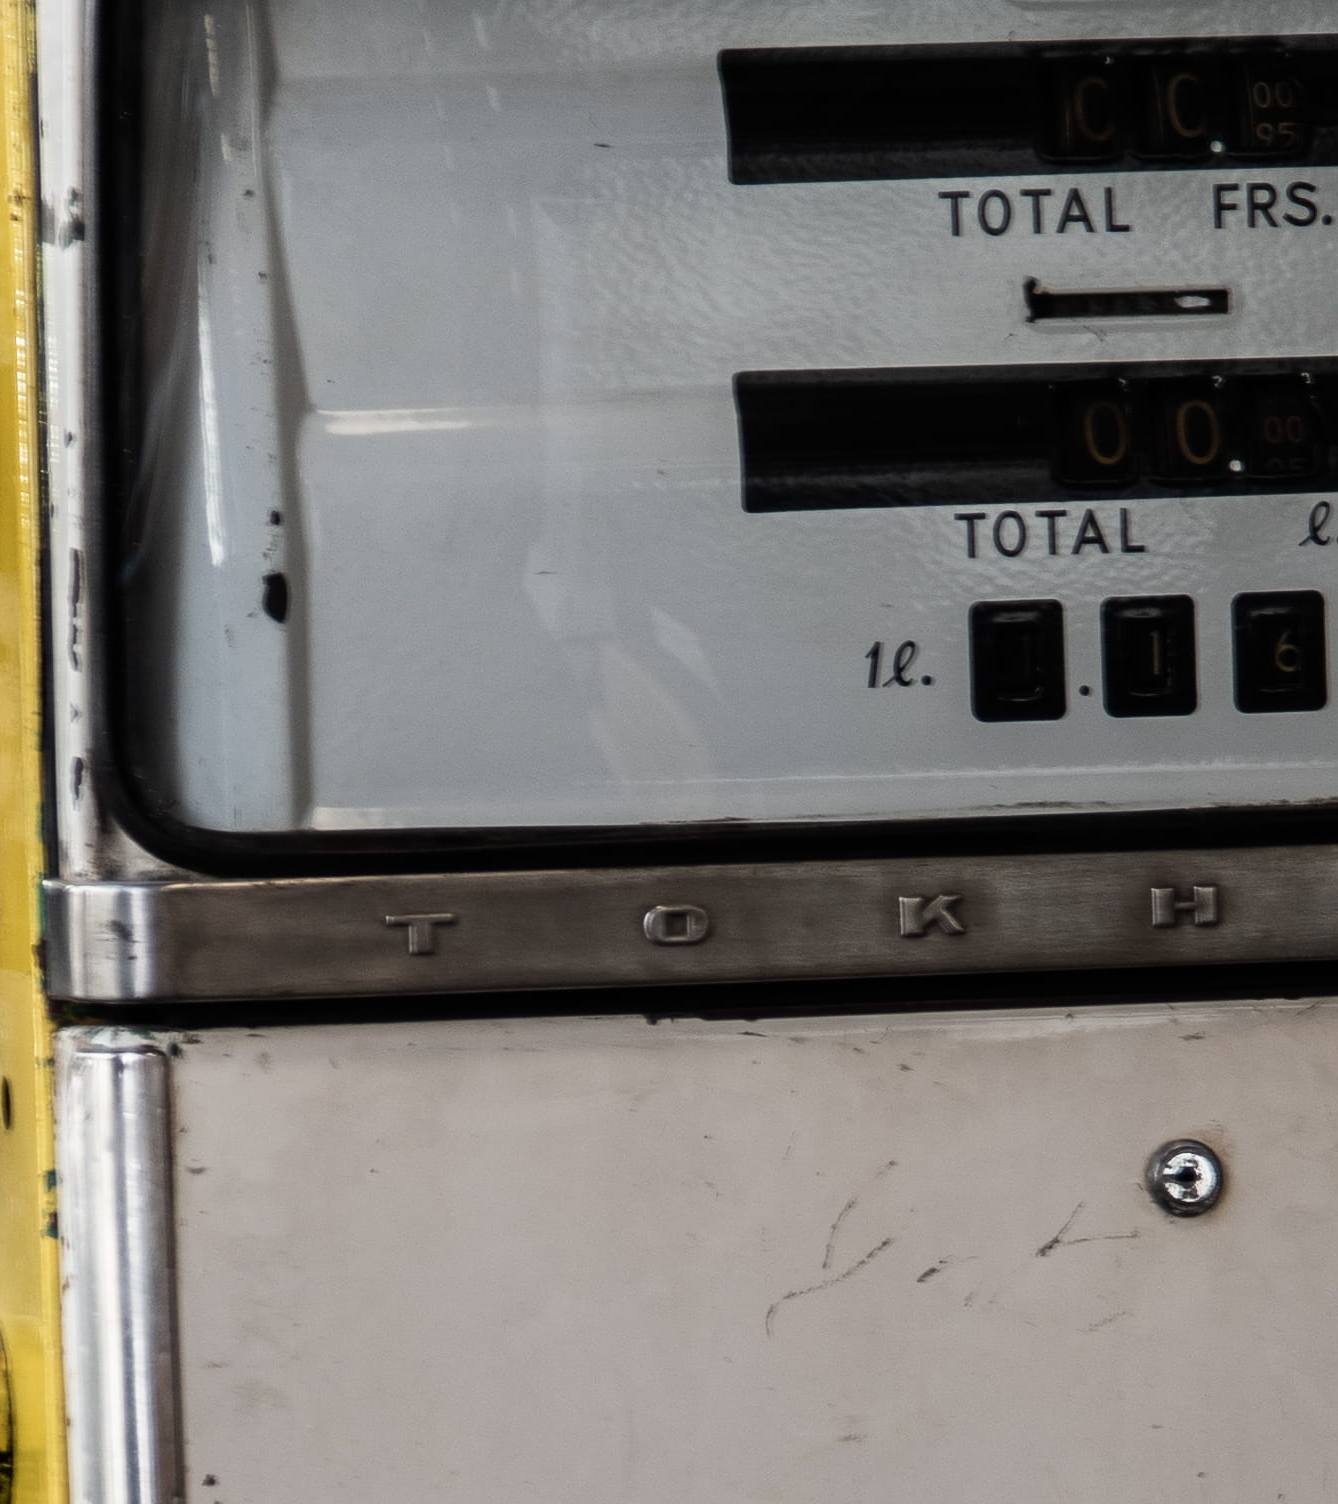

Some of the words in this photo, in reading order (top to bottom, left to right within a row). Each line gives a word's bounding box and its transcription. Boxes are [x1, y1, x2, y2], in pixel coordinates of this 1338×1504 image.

[937, 185, 1132, 237] TOTAL
[1213, 181, 1334, 230] FRS.
[954, 507, 1149, 559] TOTAL
